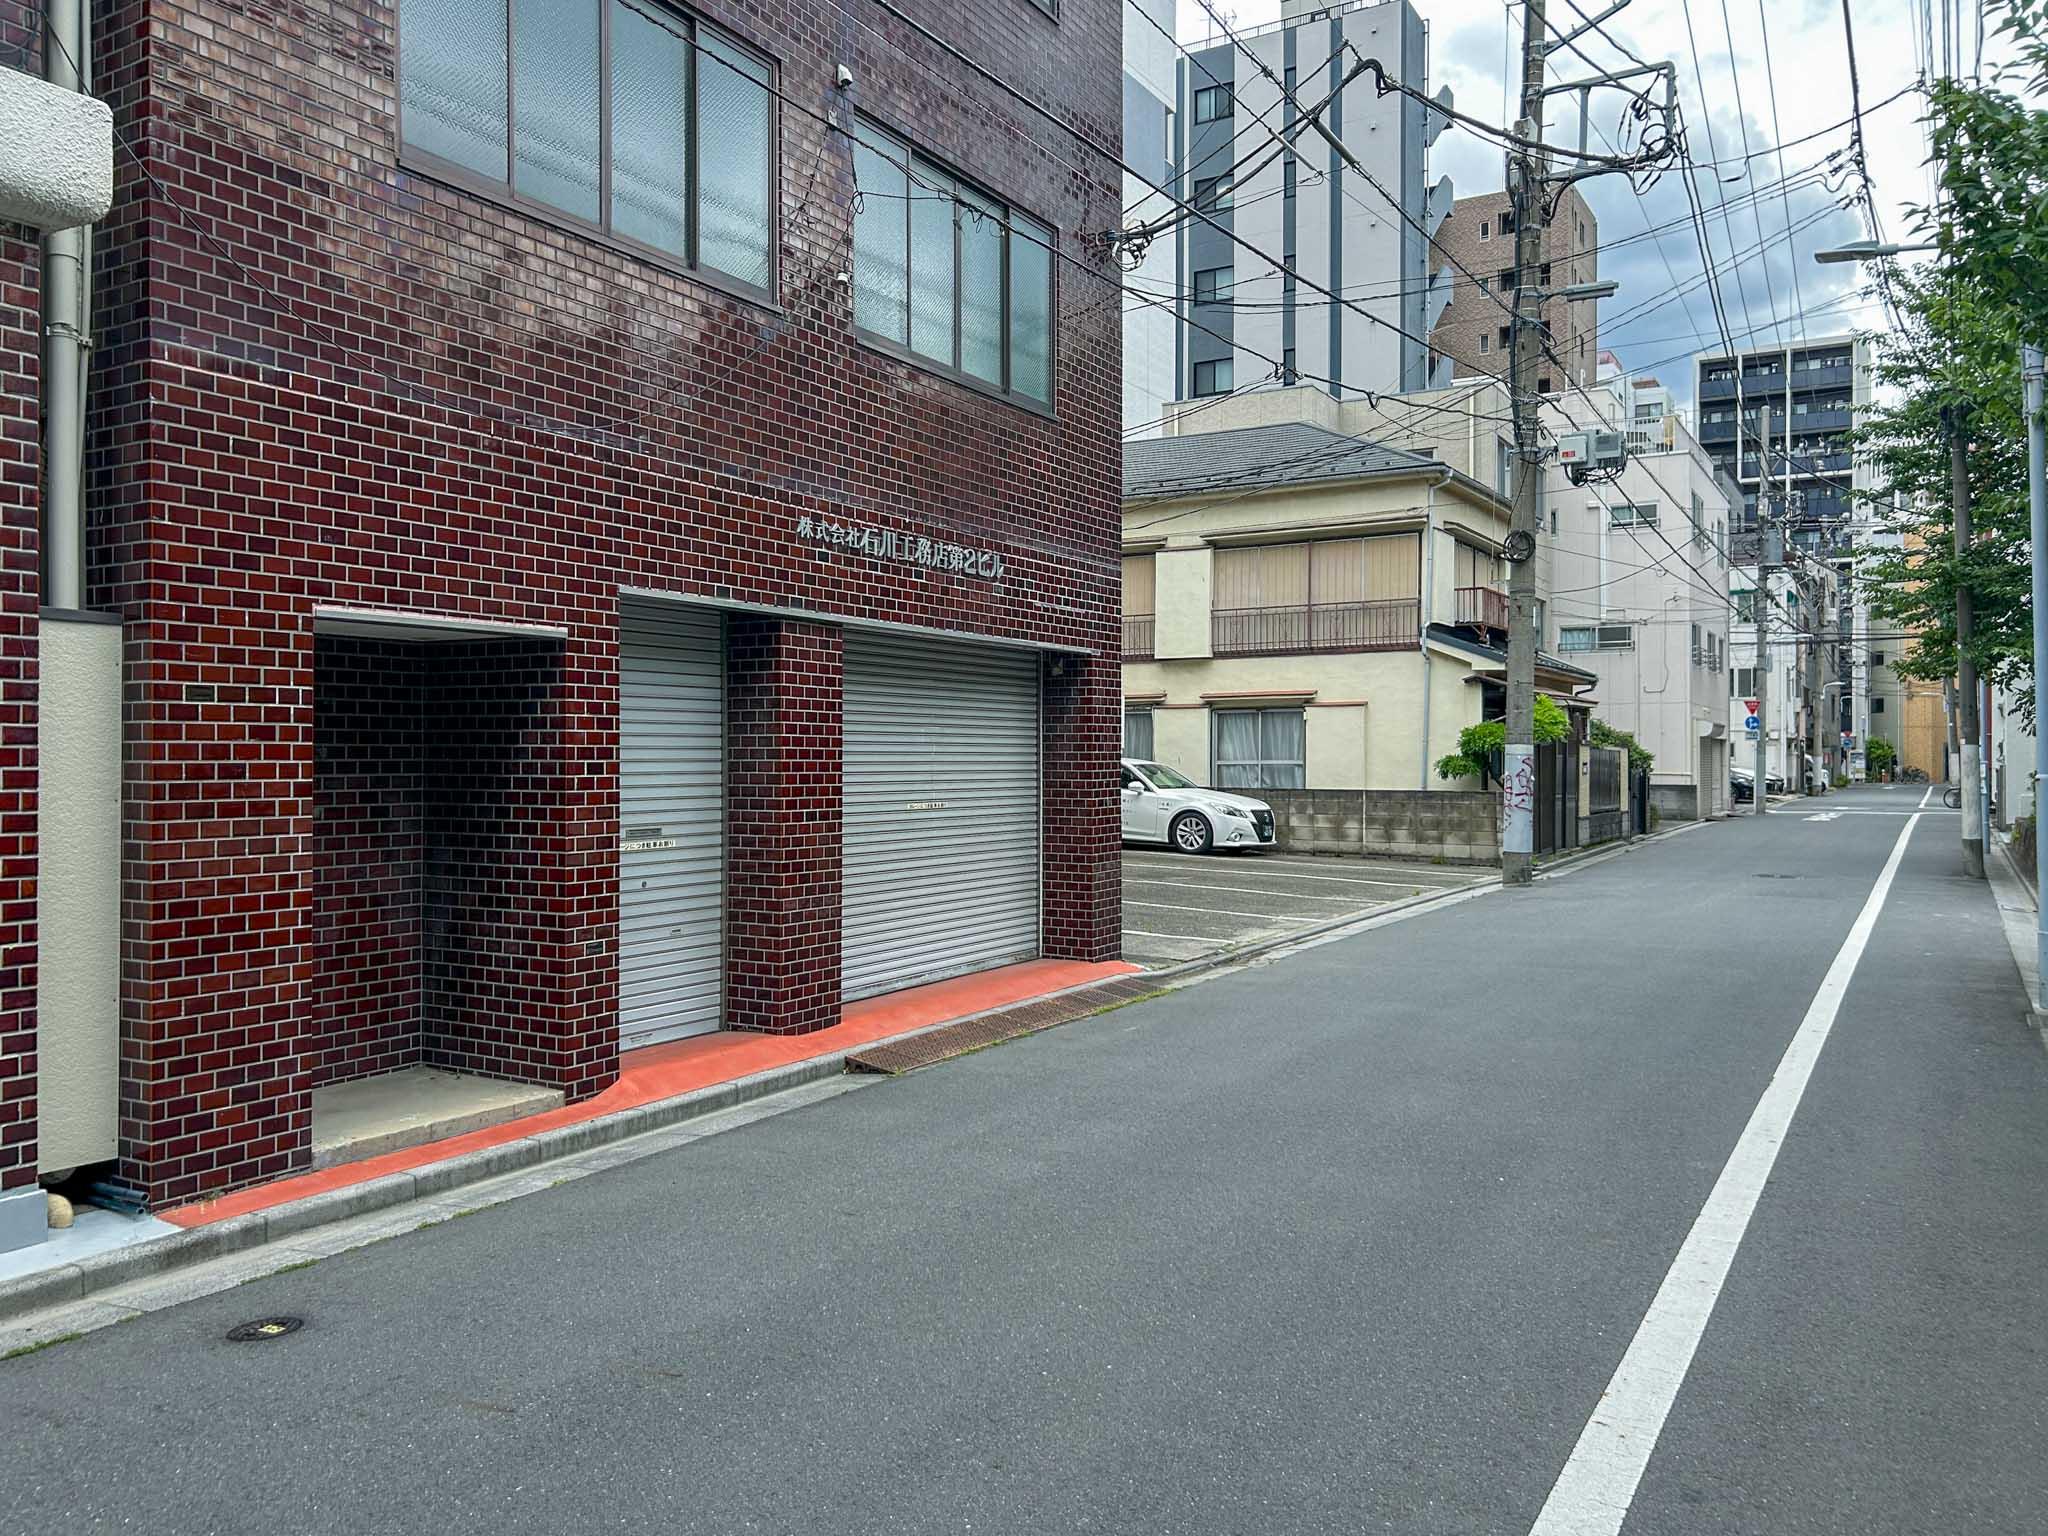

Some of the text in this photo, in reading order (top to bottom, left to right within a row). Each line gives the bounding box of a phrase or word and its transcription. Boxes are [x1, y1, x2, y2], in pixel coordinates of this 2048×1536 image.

[797, 516, 1004, 578] 株式会社石川工務店第2ビル
